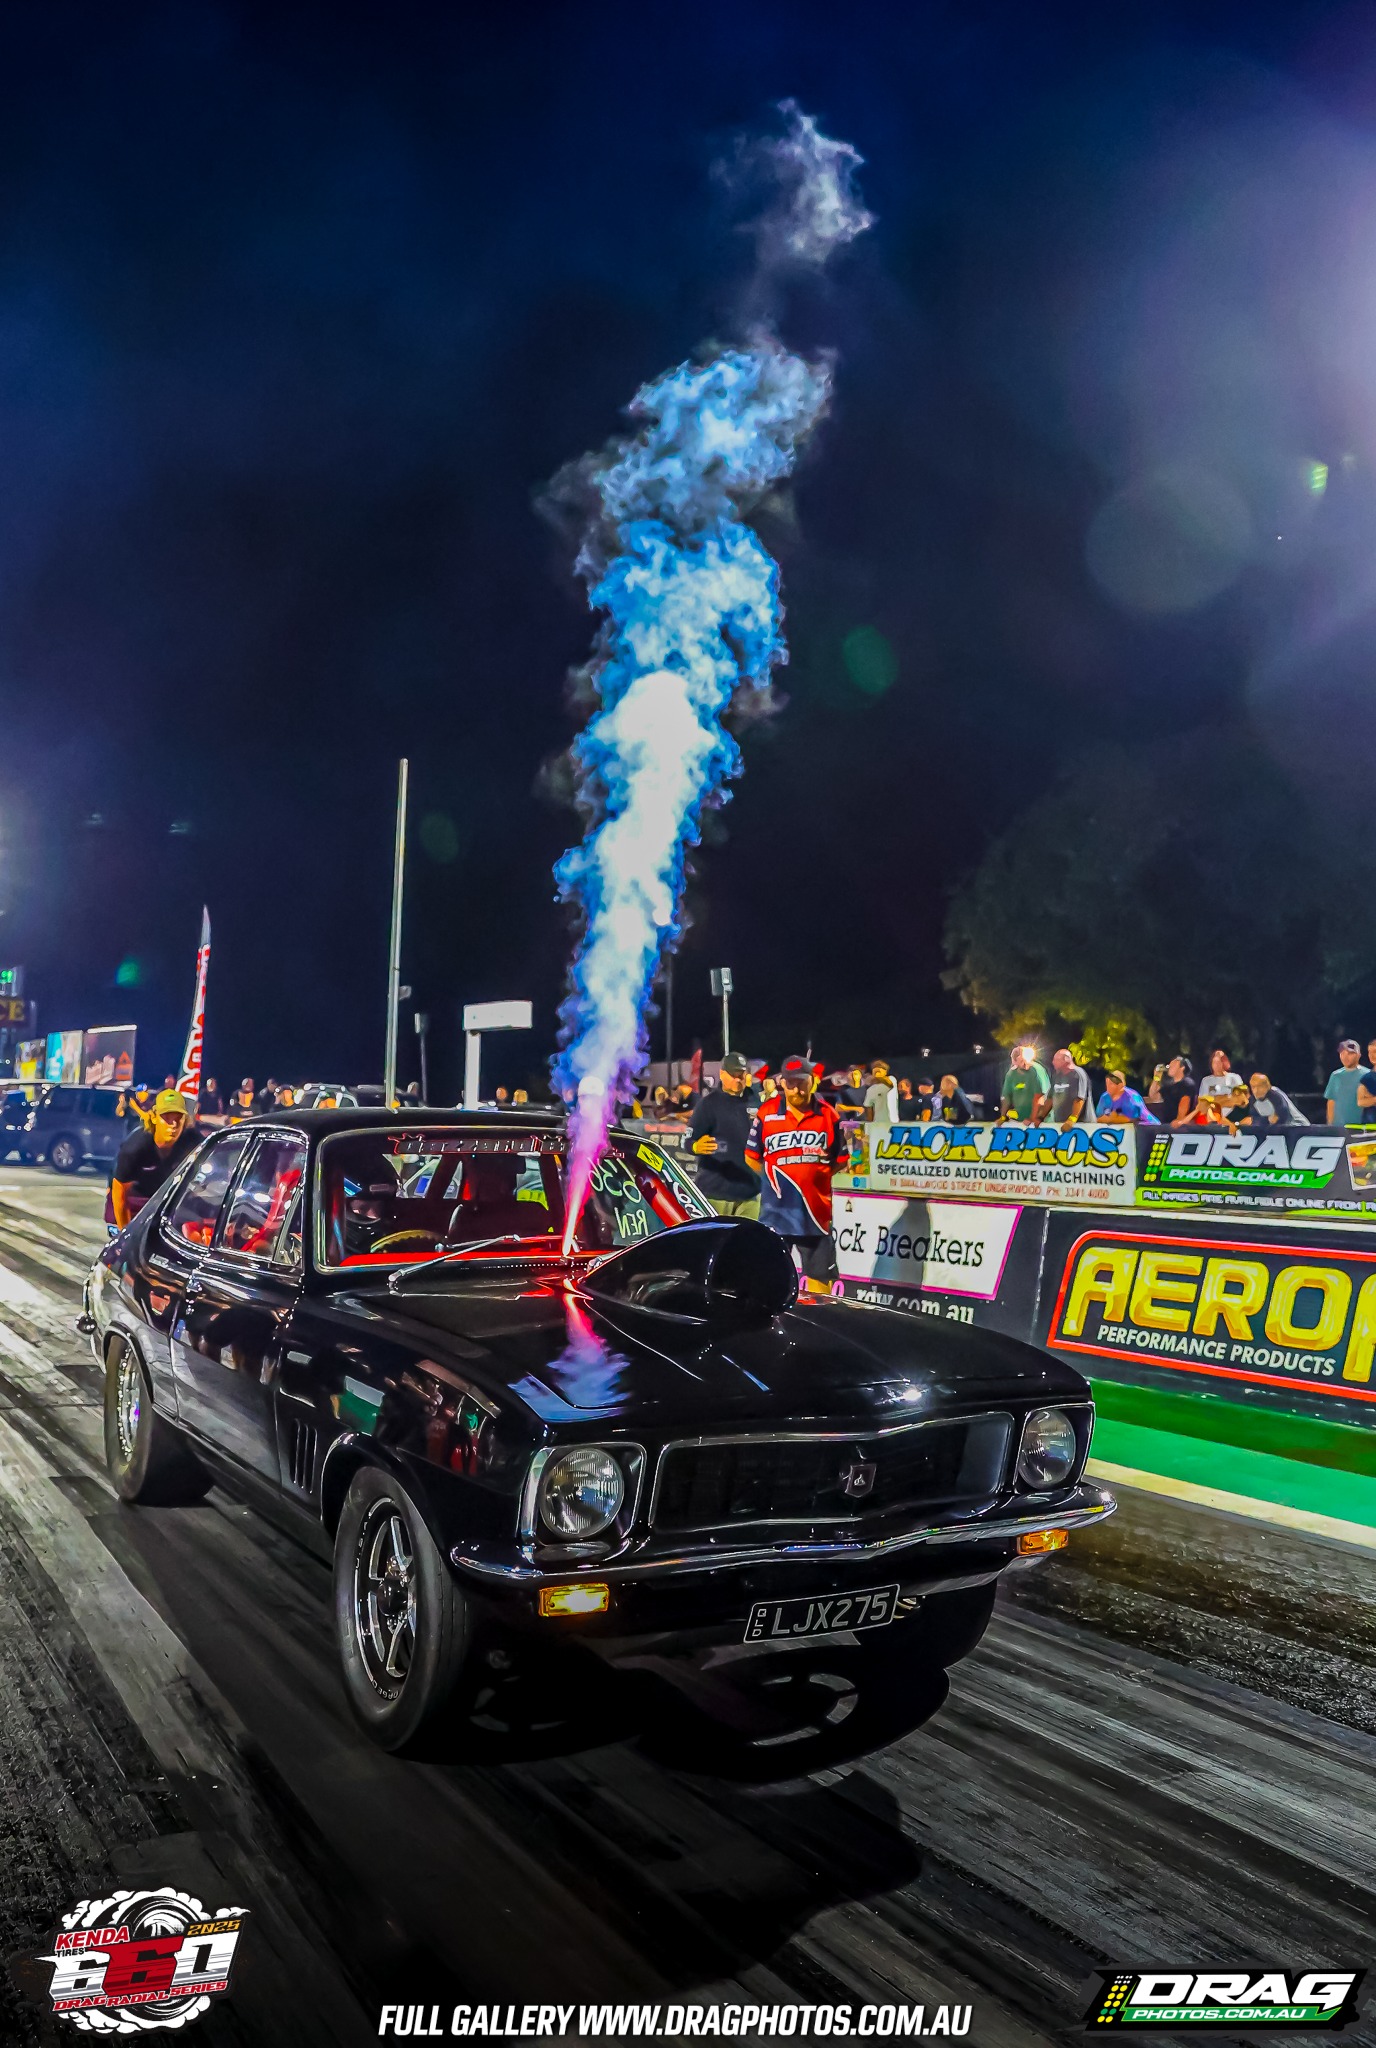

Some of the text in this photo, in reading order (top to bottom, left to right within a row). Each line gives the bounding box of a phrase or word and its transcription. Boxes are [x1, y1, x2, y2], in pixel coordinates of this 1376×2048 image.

[767, 1131, 827, 1151] KENDA
[875, 1125, 1128, 1168] JACK BROS.
[1166, 1134, 1345, 1177] DRAG
[877, 1163, 1126, 1187] SPECIALIZED AUTOMOTIVE MACHINING
[950, 1181, 983, 1192] STREET
[984, 1183, 1042, 1196] UNDERWOOD
[1168, 1168, 1305, 1185] PHOTOS.COM.AU
[1285, 1197, 1325, 1210] ONLINE
[874, 1225, 985, 1268] Breakers
[1097, 1323, 1337, 1377] PERFORMANCE PRODUCTS
[771, 1592, 890, 1635] LJX275
